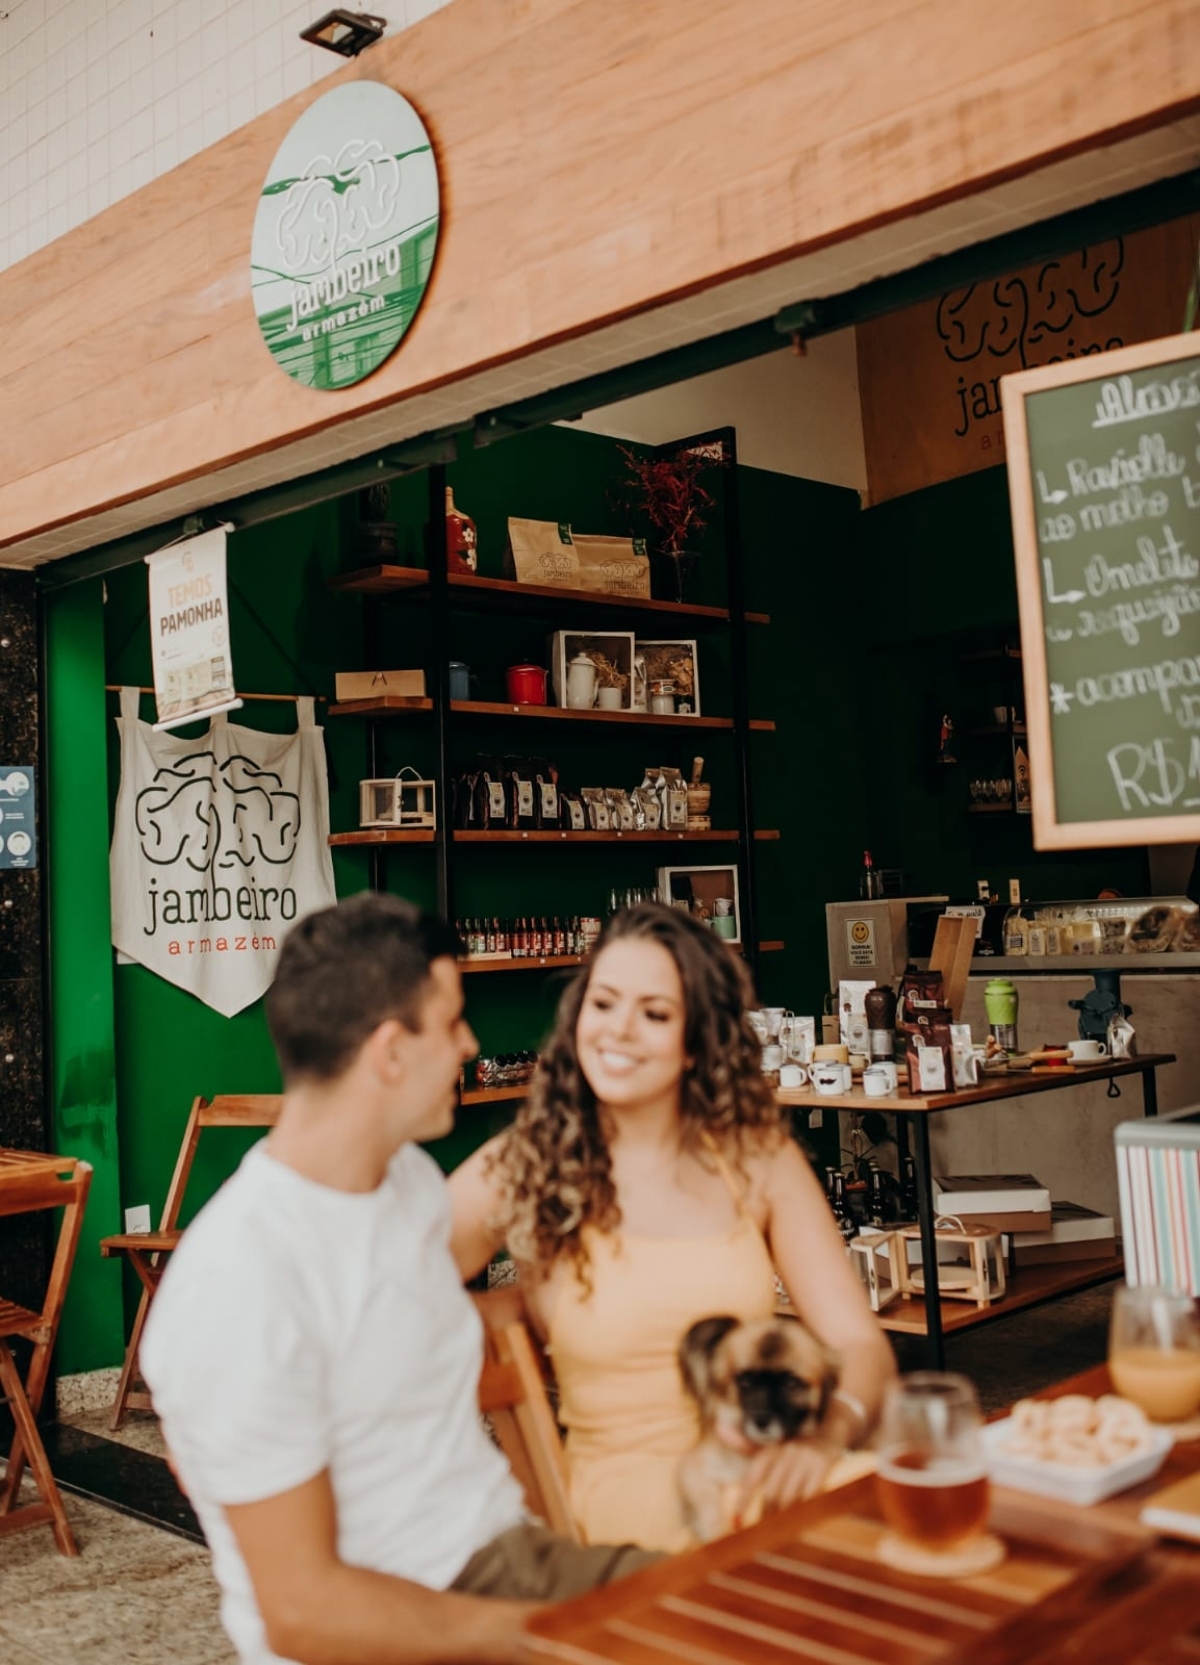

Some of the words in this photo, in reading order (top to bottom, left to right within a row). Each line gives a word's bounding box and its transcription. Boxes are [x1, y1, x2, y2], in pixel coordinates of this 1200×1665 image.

[286, 243, 401, 333] jambeiro
[301, 293, 386, 342] armazém
[167, 574, 213, 609] TEMOS
[160, 597, 223, 638] PAMONHA
[1076, 657, 1200, 714] acompa
[143, 878, 297, 936] jambeiro
[167, 933, 277, 956] armazém
